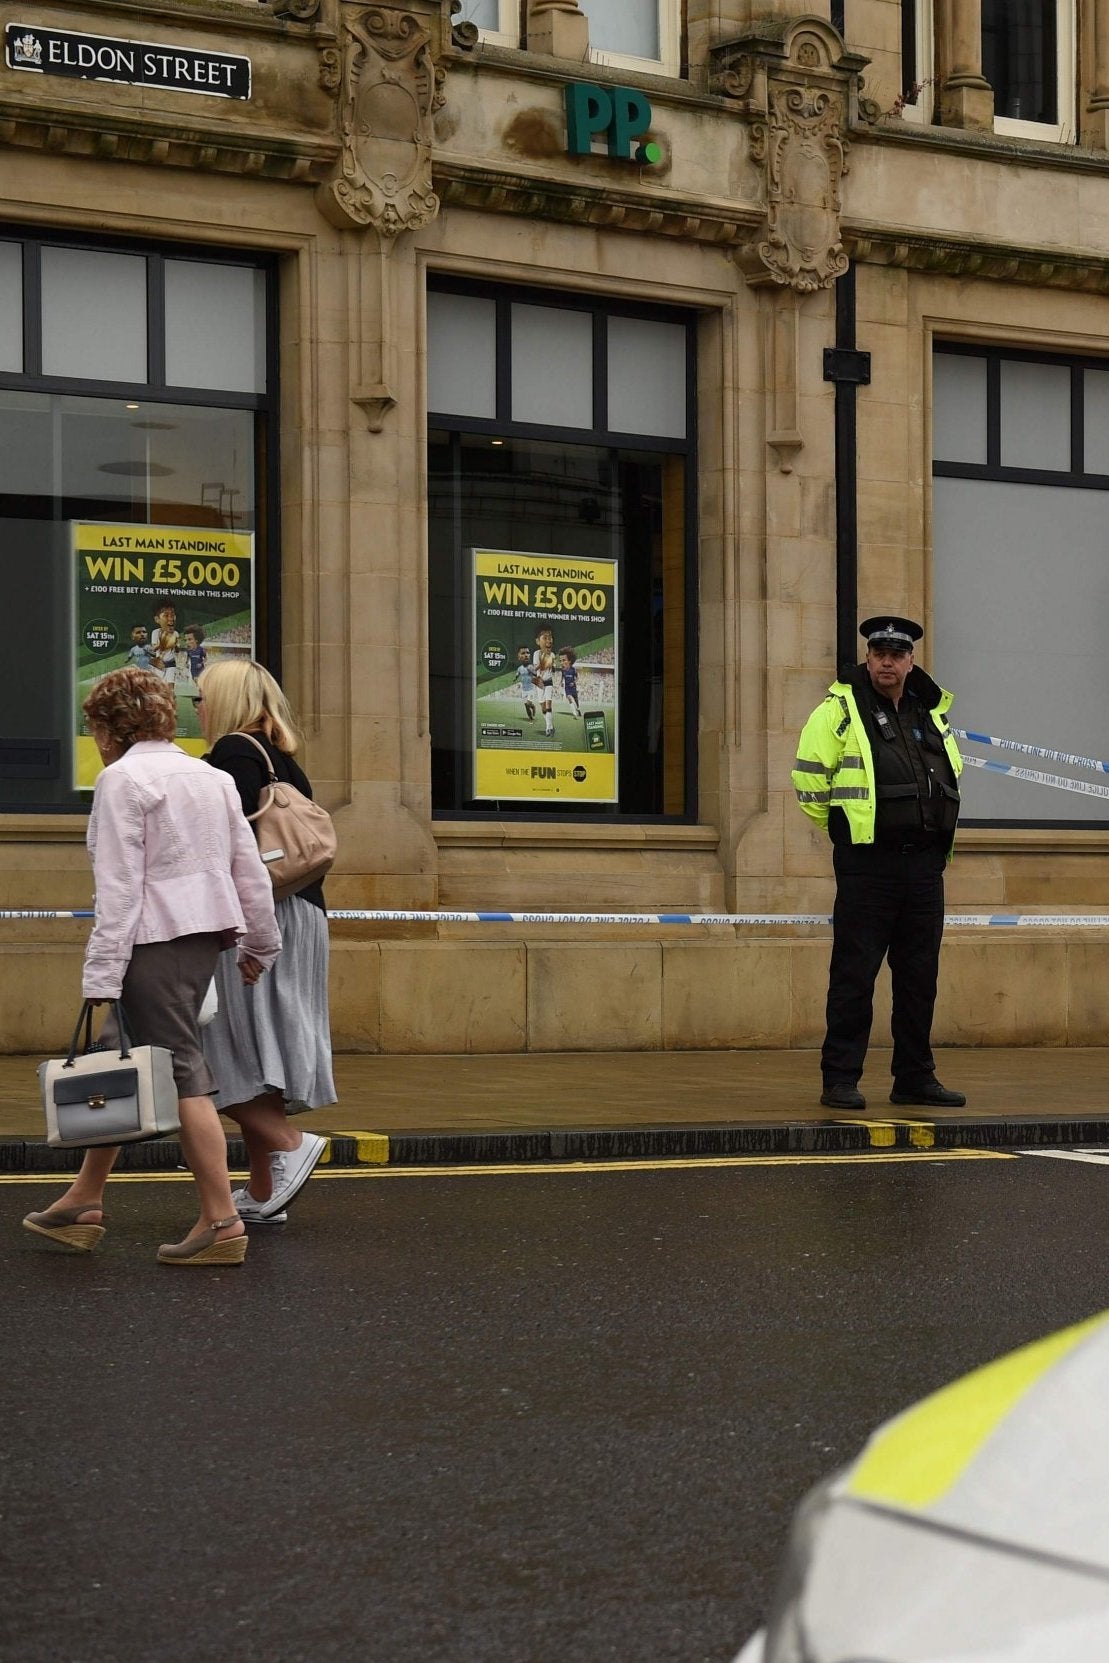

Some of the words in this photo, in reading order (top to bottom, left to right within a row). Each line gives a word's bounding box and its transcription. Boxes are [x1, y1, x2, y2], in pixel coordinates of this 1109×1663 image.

[49, 40, 135, 73] ELDON
[144, 54, 236, 87] STREET
[103, 536, 132, 547] LAST
[135, 537, 165, 550] MAN
[169, 540, 226, 553] STANDING
[85, 556, 144, 582] WIN
[152, 559, 240, 587] £5,000
[498, 564, 520, 575] LAST
[522, 567, 544, 577] MAN
[547, 568, 594, 580] STANDING
[109, 586, 125, 594] FREE
[171, 589, 197, 597] WINNER
[207, 590, 221, 598] THIS
[484, 582, 529, 606] WIN
[535, 586, 606, 613] £5,000
[531, 767, 557, 780] FUN
